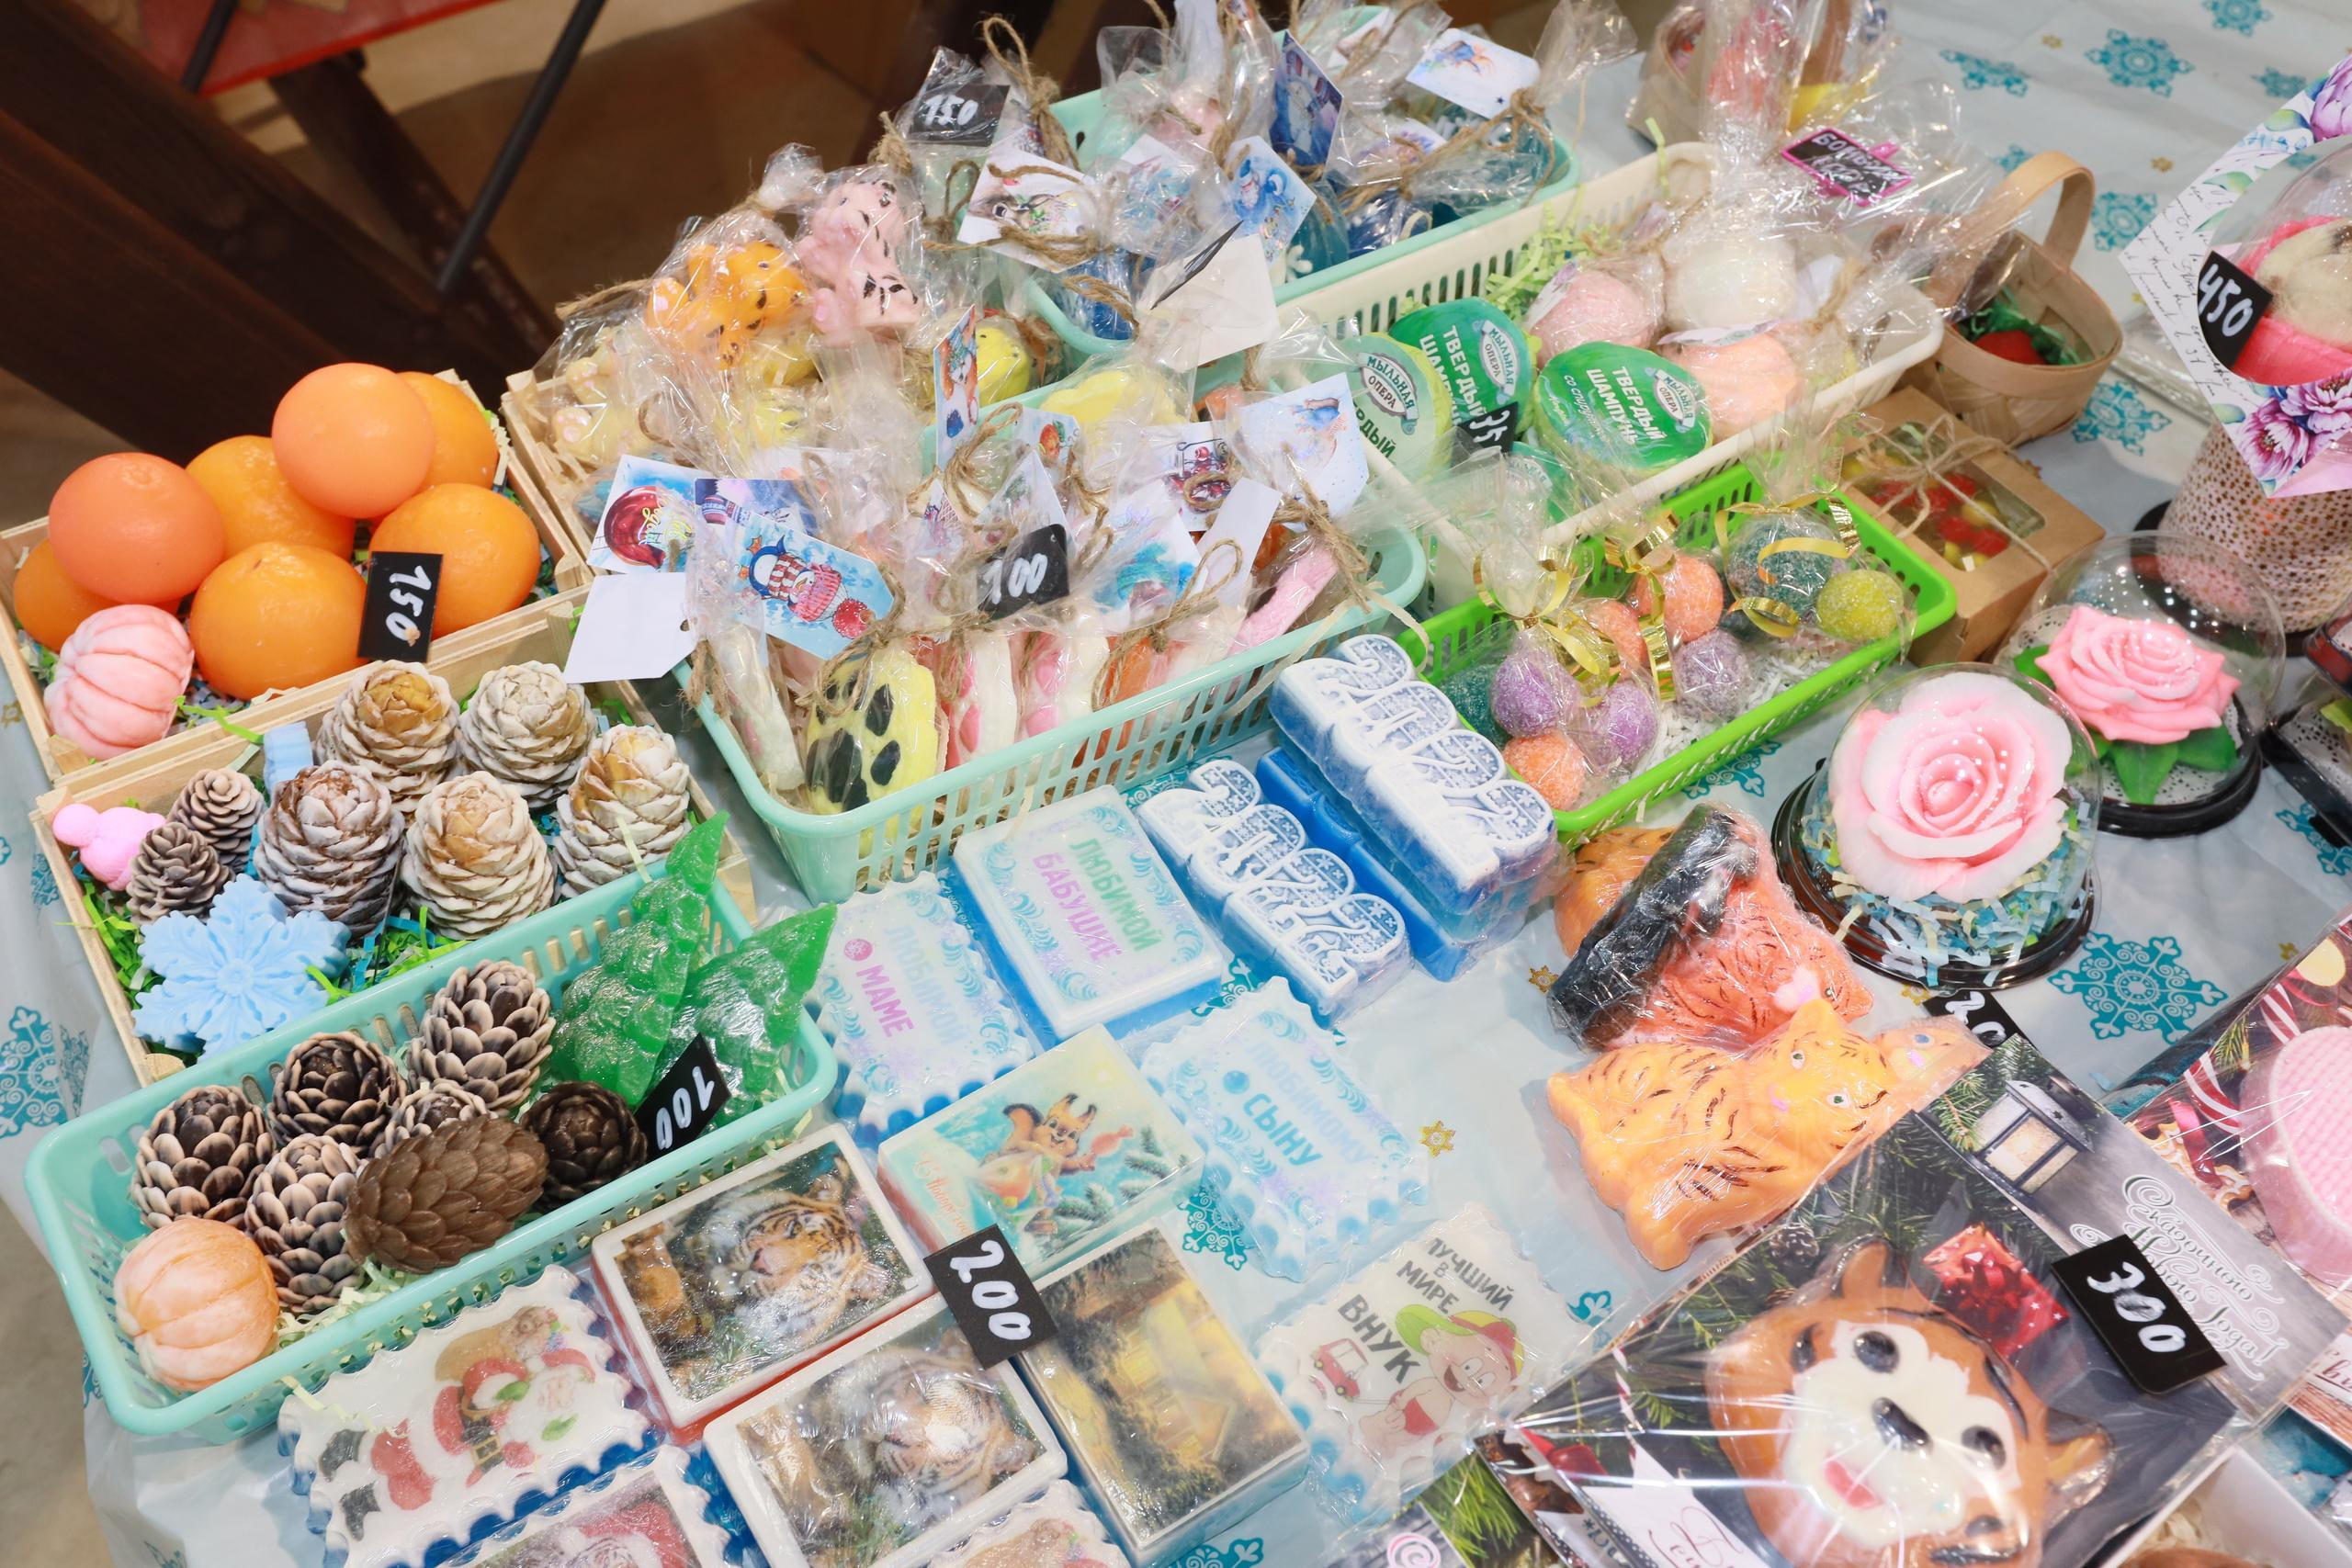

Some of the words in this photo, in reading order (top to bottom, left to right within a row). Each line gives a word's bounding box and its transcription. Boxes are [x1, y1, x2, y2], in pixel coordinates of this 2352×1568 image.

[922, 93, 978, 128] 150
[2199, 263, 2254, 337] 450
[1366, 356, 1416, 410] МЫЛЬНАЯ
[1368, 375, 1397, 409] ОПЕРА
[1442, 324, 1487, 418] ТВЕРДЫЙ
[1484, 343, 1501, 378] ОПЕРА
[1488, 328, 1515, 386] МЫЛЬНАЯ
[1564, 375, 1577, 388] со
[1586, 368, 1639, 446] ШАМПУНЬ
[1612, 367, 1668, 440] ТВЕРДЫЙ
[1659, 386, 1678, 413] ОПЕРА
[1664, 376, 1694, 419] МЫЛЬНАЯ
[385, 564, 433, 649] 150
[984, 554, 1048, 606] 100
[1275, 634, 1556, 893] 2022
[1033, 852, 1123, 962] БАБУШКЕ
[1069, 838, 1164, 953] ЛЮБИМОЙ
[1137, 760, 1407, 996] 2022
[855, 964, 915, 1038] МАМЕ
[655, 1064, 714, 1150] 100
[1242, 1093, 1323, 1167] СЫНУ
[949, 1240, 1033, 1341] 200
[1396, 1259, 1461, 1314] МИРЕ
[2086, 1261, 2187, 1353] 300
[1337, 1293, 1421, 1383] ВНУК
